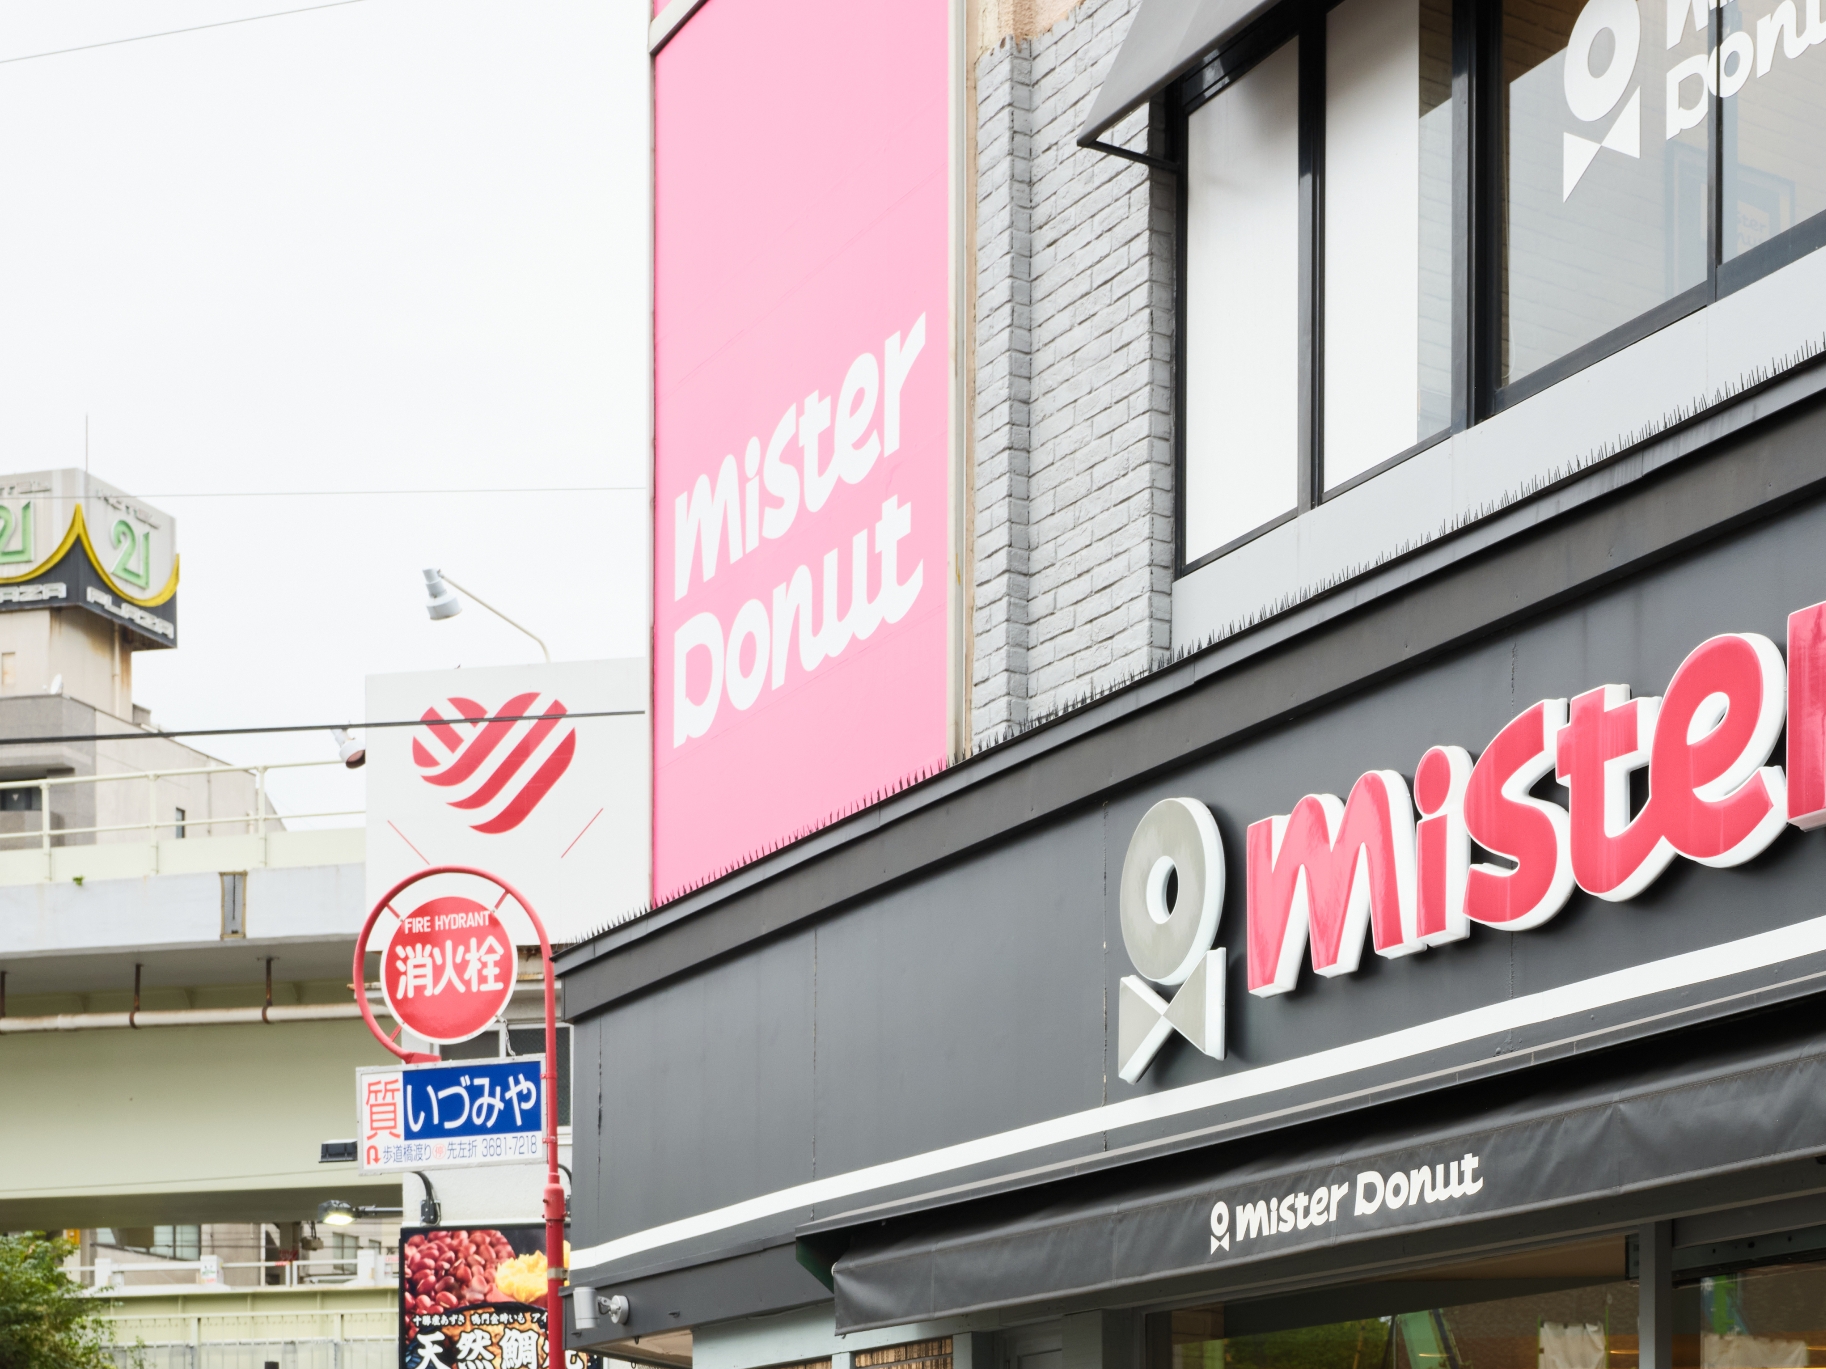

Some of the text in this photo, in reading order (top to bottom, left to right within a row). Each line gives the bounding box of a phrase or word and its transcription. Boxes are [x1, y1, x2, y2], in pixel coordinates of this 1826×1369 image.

[675, 311, 925, 602] mister
[111, 519, 150, 590] 21
[86, 586, 174, 639] PLAZA
[674, 494, 923, 749] Donut
[404, 911, 491, 934] FIRE HYDRANT
[395, 935, 505, 1000] 消火栓
[365, 1073, 537, 1141] 質 いづみや
[481, 1134, 538, 1158] 3681-7218
[1236, 1152, 1484, 1242] mister Donut
